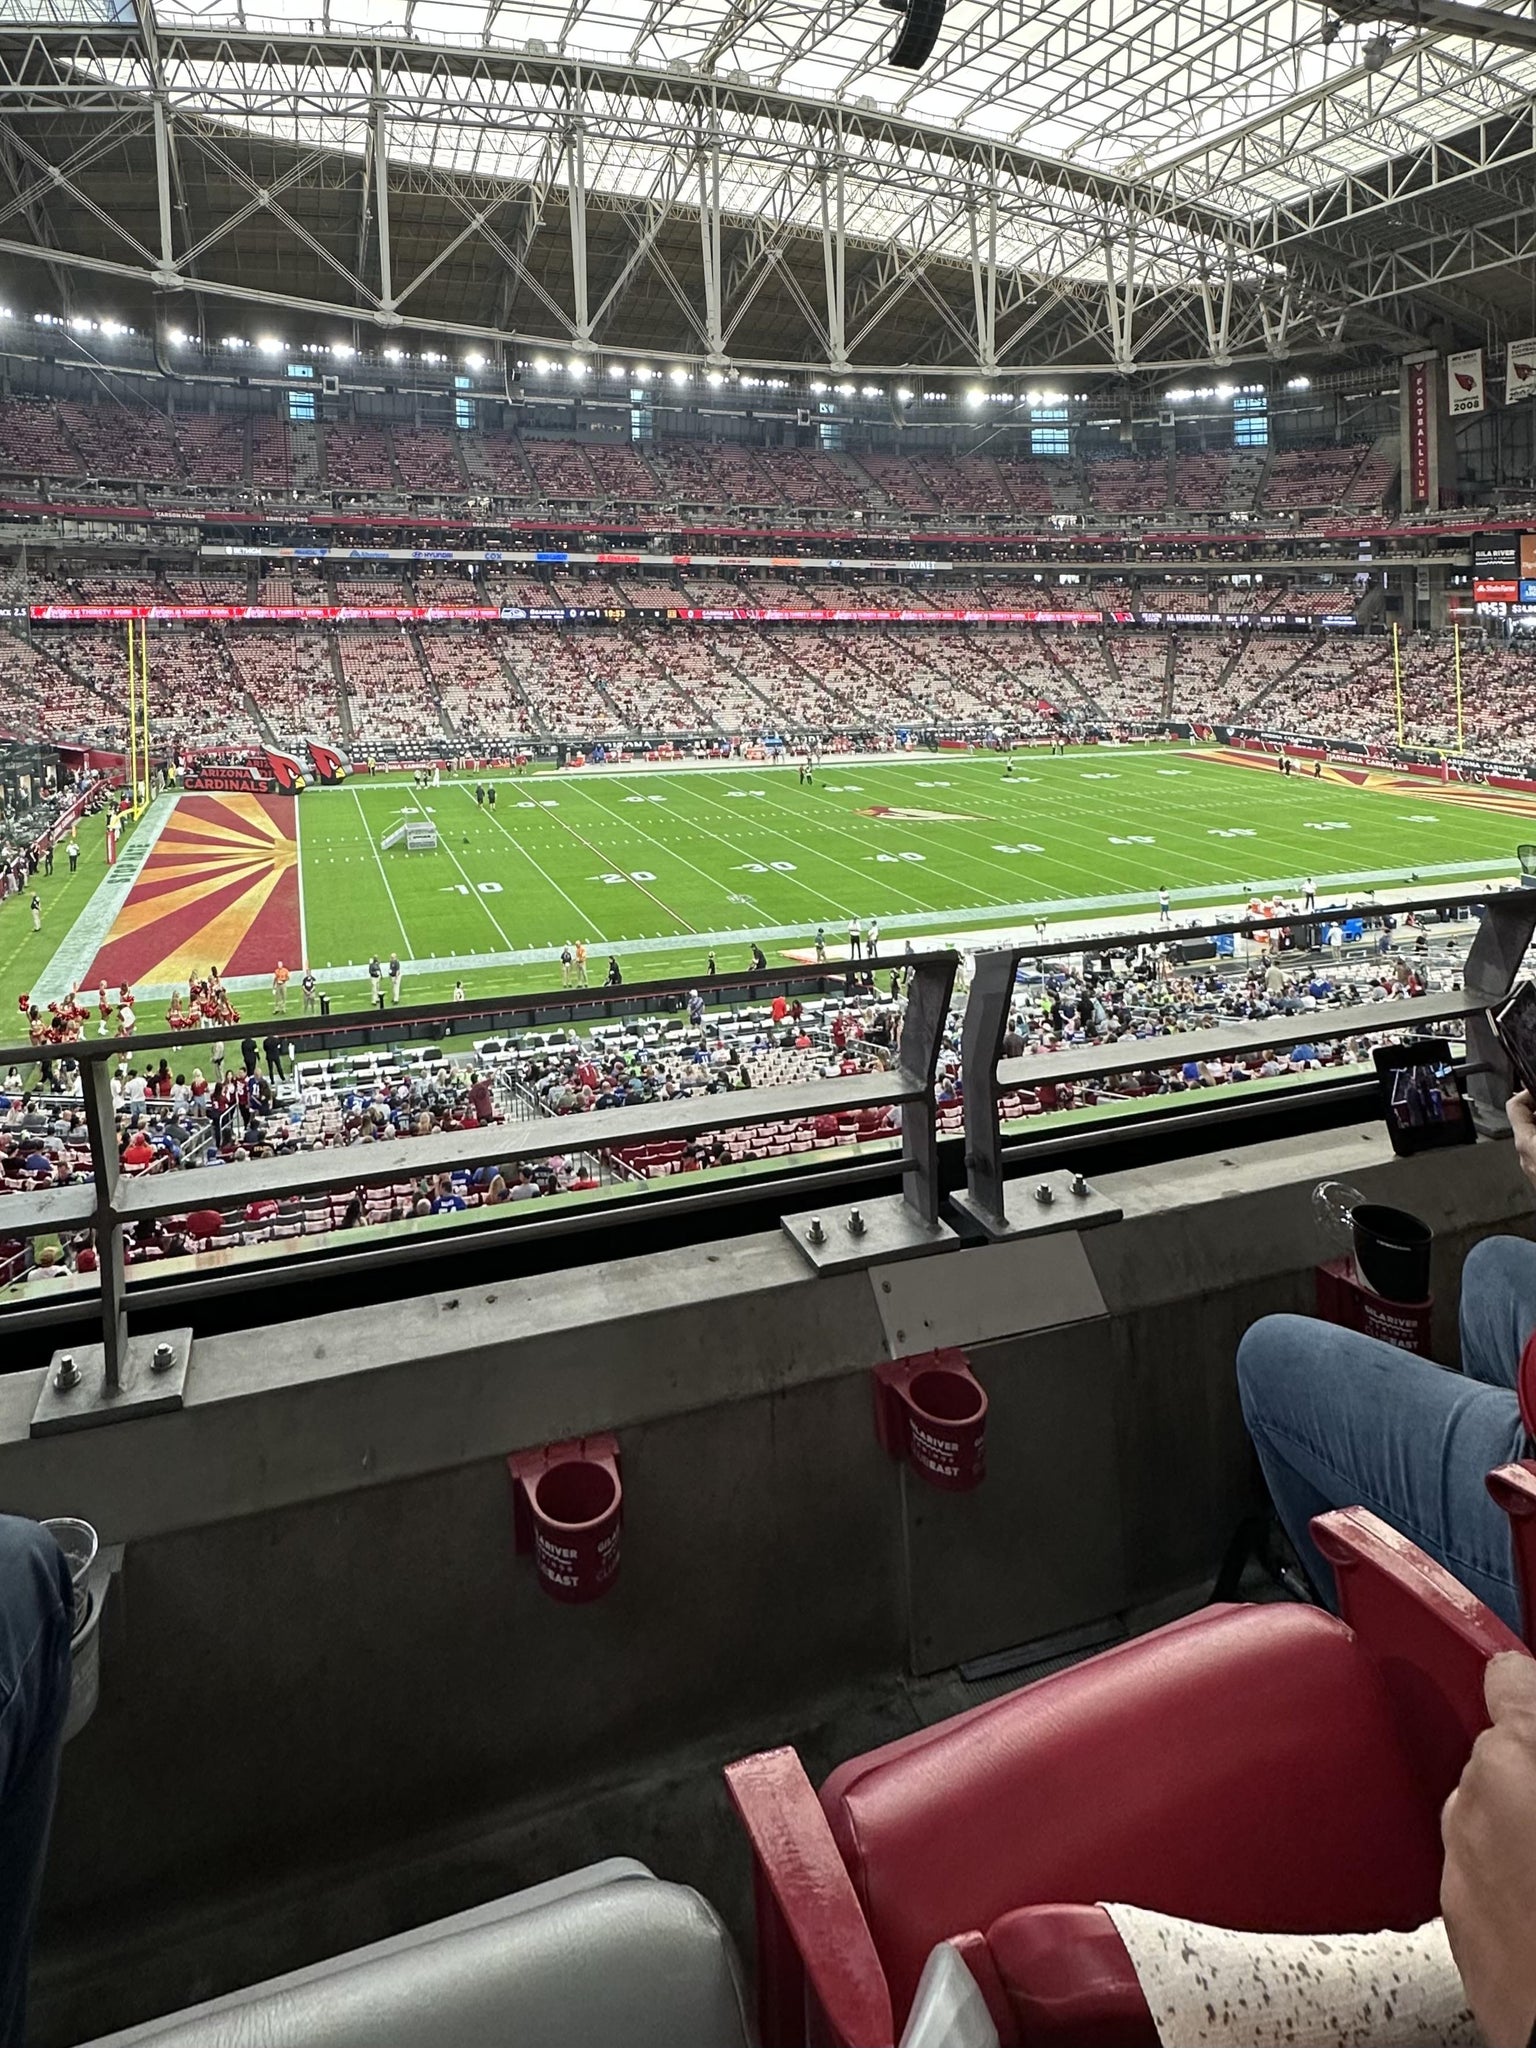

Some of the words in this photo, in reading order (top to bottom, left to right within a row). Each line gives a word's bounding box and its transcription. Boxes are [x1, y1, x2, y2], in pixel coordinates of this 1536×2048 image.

[1454, 400, 1480, 411] 2008
[1416, 377, 1424, 456] FOOTBALL
[156, 511, 182, 519] CARSON
[182, 512, 206, 520] PALMER
[485, 552, 502, 560] COX
[1493, 549, 1515, 557] RIVER
[909, 560, 936, 570] AVNET
[14, 607, 27, 617] 2.5
[81, 608, 111, 616] THIRSTY
[569, 609, 577, 617] 0
[1176, 614, 1211, 622] HARRISON
[1212, 614, 1222, 622] JR.
[1331, 752, 1363, 764] ARIZONA
[1448, 757, 1480, 769] ARIZONA
[1483, 763, 1528, 775] CARDINALS
[200, 768, 251, 779] ARIZONA
[184, 778, 269, 793] CARDINALS
[991, 843, 1045, 853] 50
[876, 852, 927, 863] 40
[741, 861, 798, 873] 30
[600, 871, 657, 884] 20
[454, 881, 504, 895] 10
[1386, 1315, 1419, 1328] RIVER
[926, 1433, 959, 1451] RIVER
[928, 1459, 960, 1477] EAST
[544, 1540, 578, 1559] RIVER
[547, 1568, 580, 1588] EAST
